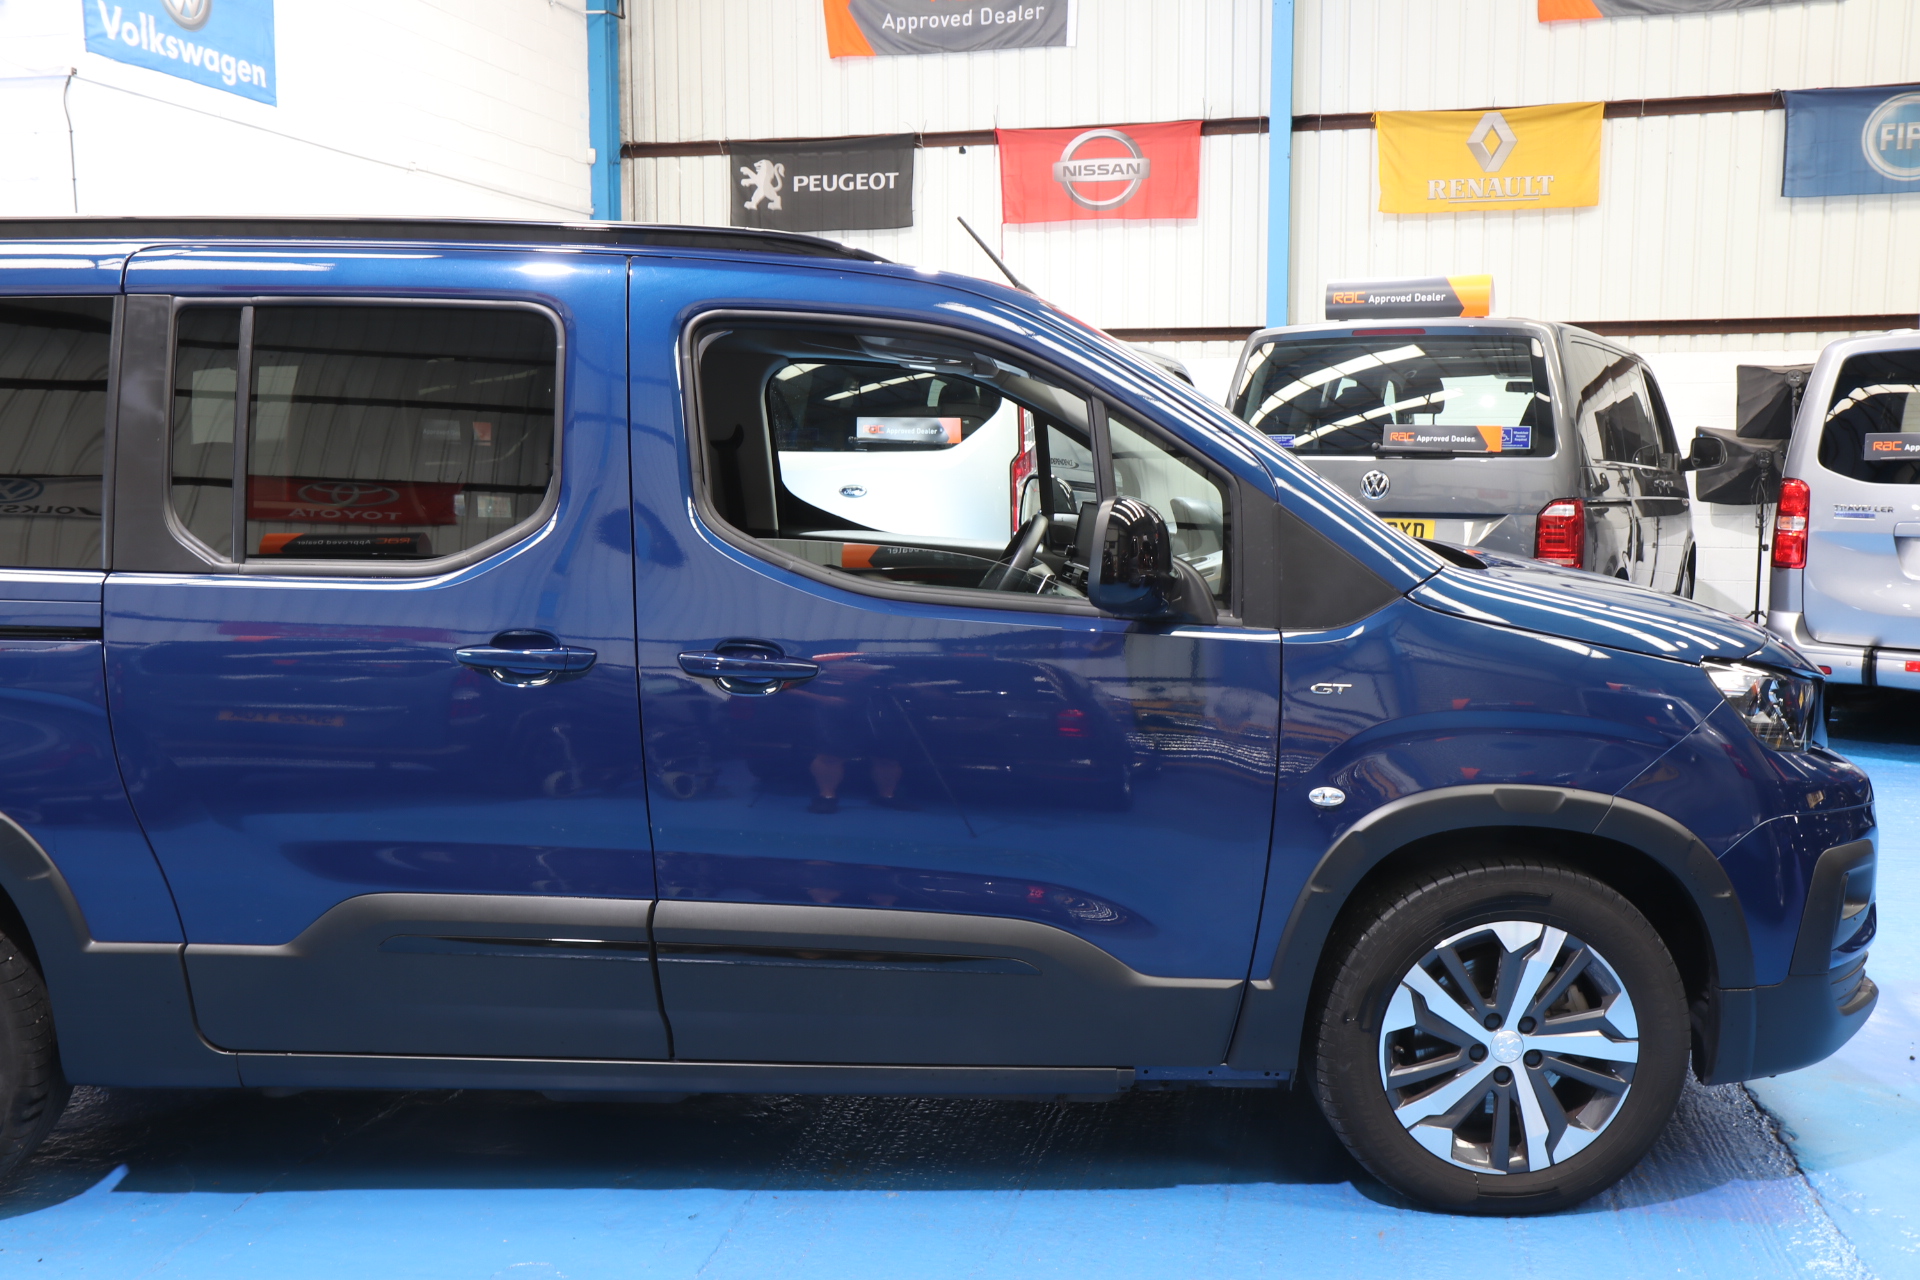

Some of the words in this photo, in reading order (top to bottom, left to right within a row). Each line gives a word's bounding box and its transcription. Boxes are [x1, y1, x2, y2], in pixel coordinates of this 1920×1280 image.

[882, 9, 973, 34] Approved
[980, 5, 1045, 26] Dealer
[97, 0, 267, 88] Volkswagen
[1880, 122, 1920, 151] FIA
[1062, 162, 1141, 178] NISSAN
[793, 172, 899, 192] PEUGEOT
[1427, 175, 1554, 200] RENAULT
[1368, 293, 1412, 305] Approved
[1414, 292, 1446, 302] Dealer
[1416, 435, 1449, 443] Approved
[1451, 435, 1476, 443] Dealer
[1833, 503, 1894, 513] TRAVELLER
[1310, 682, 1353, 695] GT
